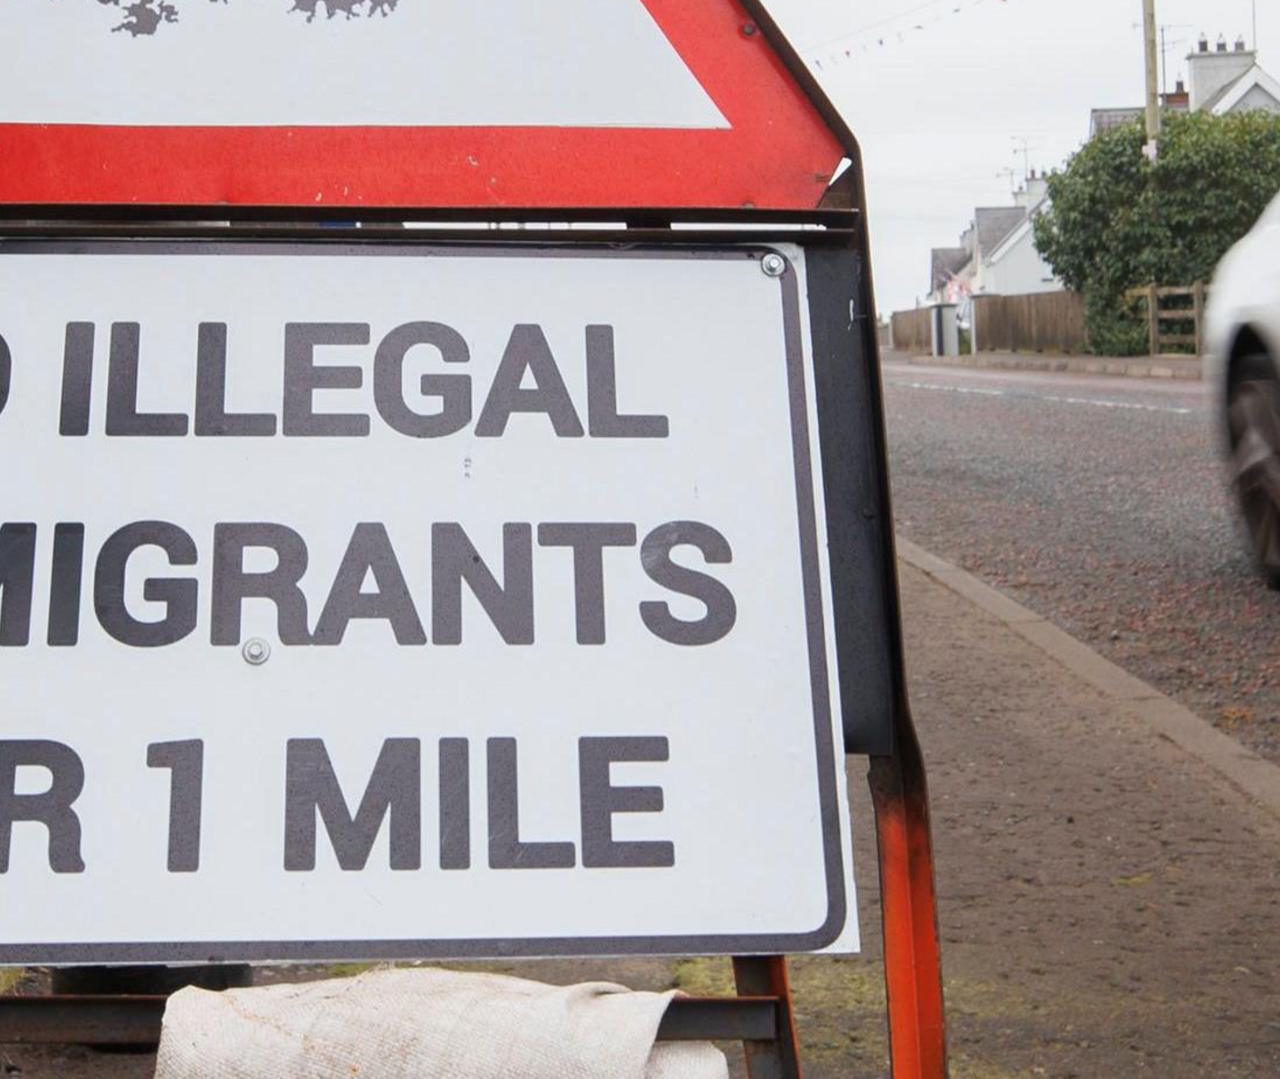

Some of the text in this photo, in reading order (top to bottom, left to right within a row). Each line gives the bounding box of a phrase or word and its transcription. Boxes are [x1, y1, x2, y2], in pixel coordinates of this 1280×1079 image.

[59, 322, 668, 438] ILLEGAL
[147, 739, 203, 872] 1
[284, 736, 674, 871] MILE
